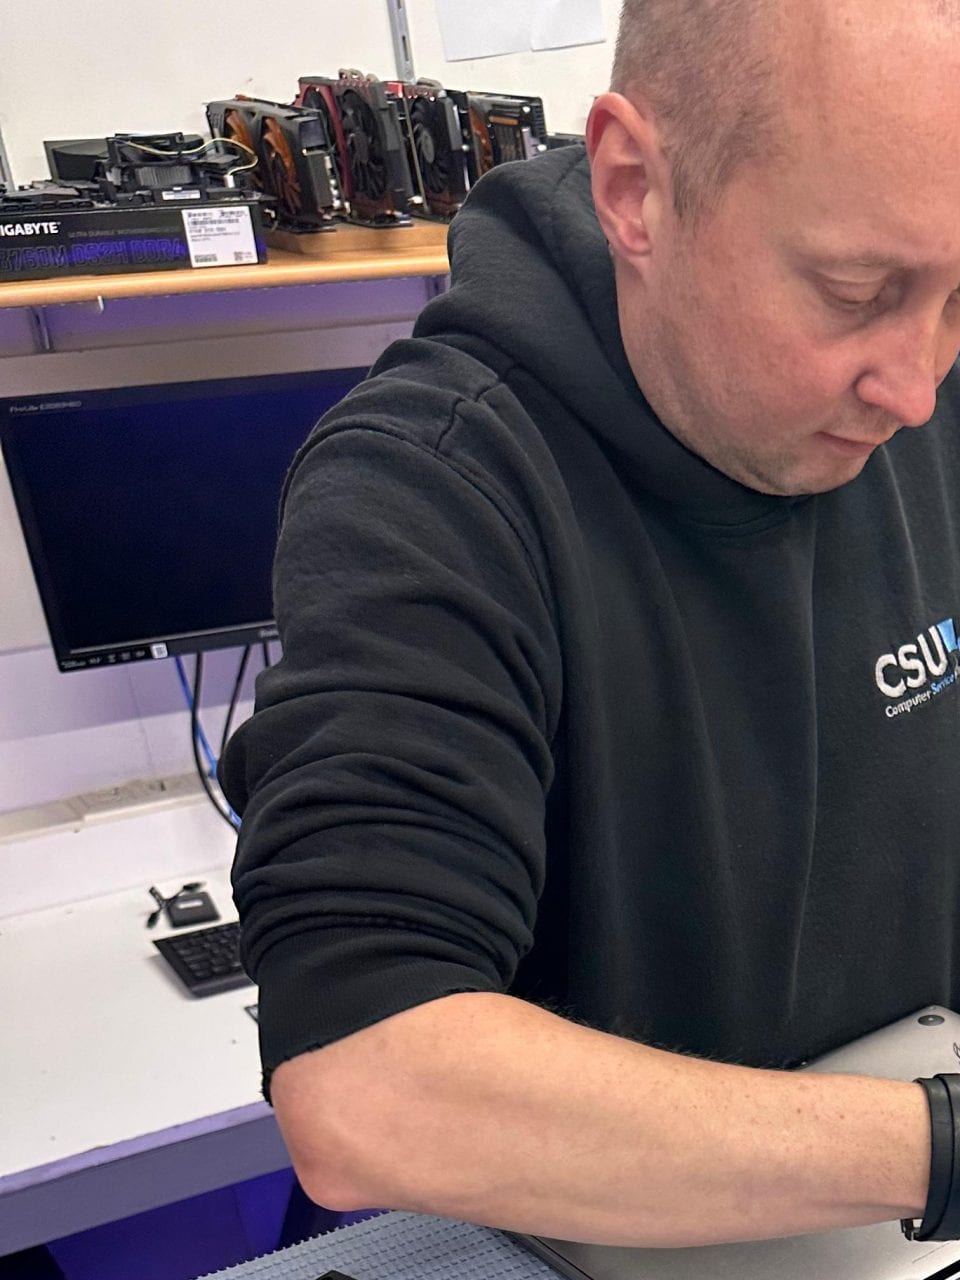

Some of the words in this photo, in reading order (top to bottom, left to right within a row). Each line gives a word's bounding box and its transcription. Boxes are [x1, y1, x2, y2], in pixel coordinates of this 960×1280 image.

[0, 222, 60, 237] IGABYTE
[875, 625, 948, 698] CSU
[885, 690, 931, 718] Computer
